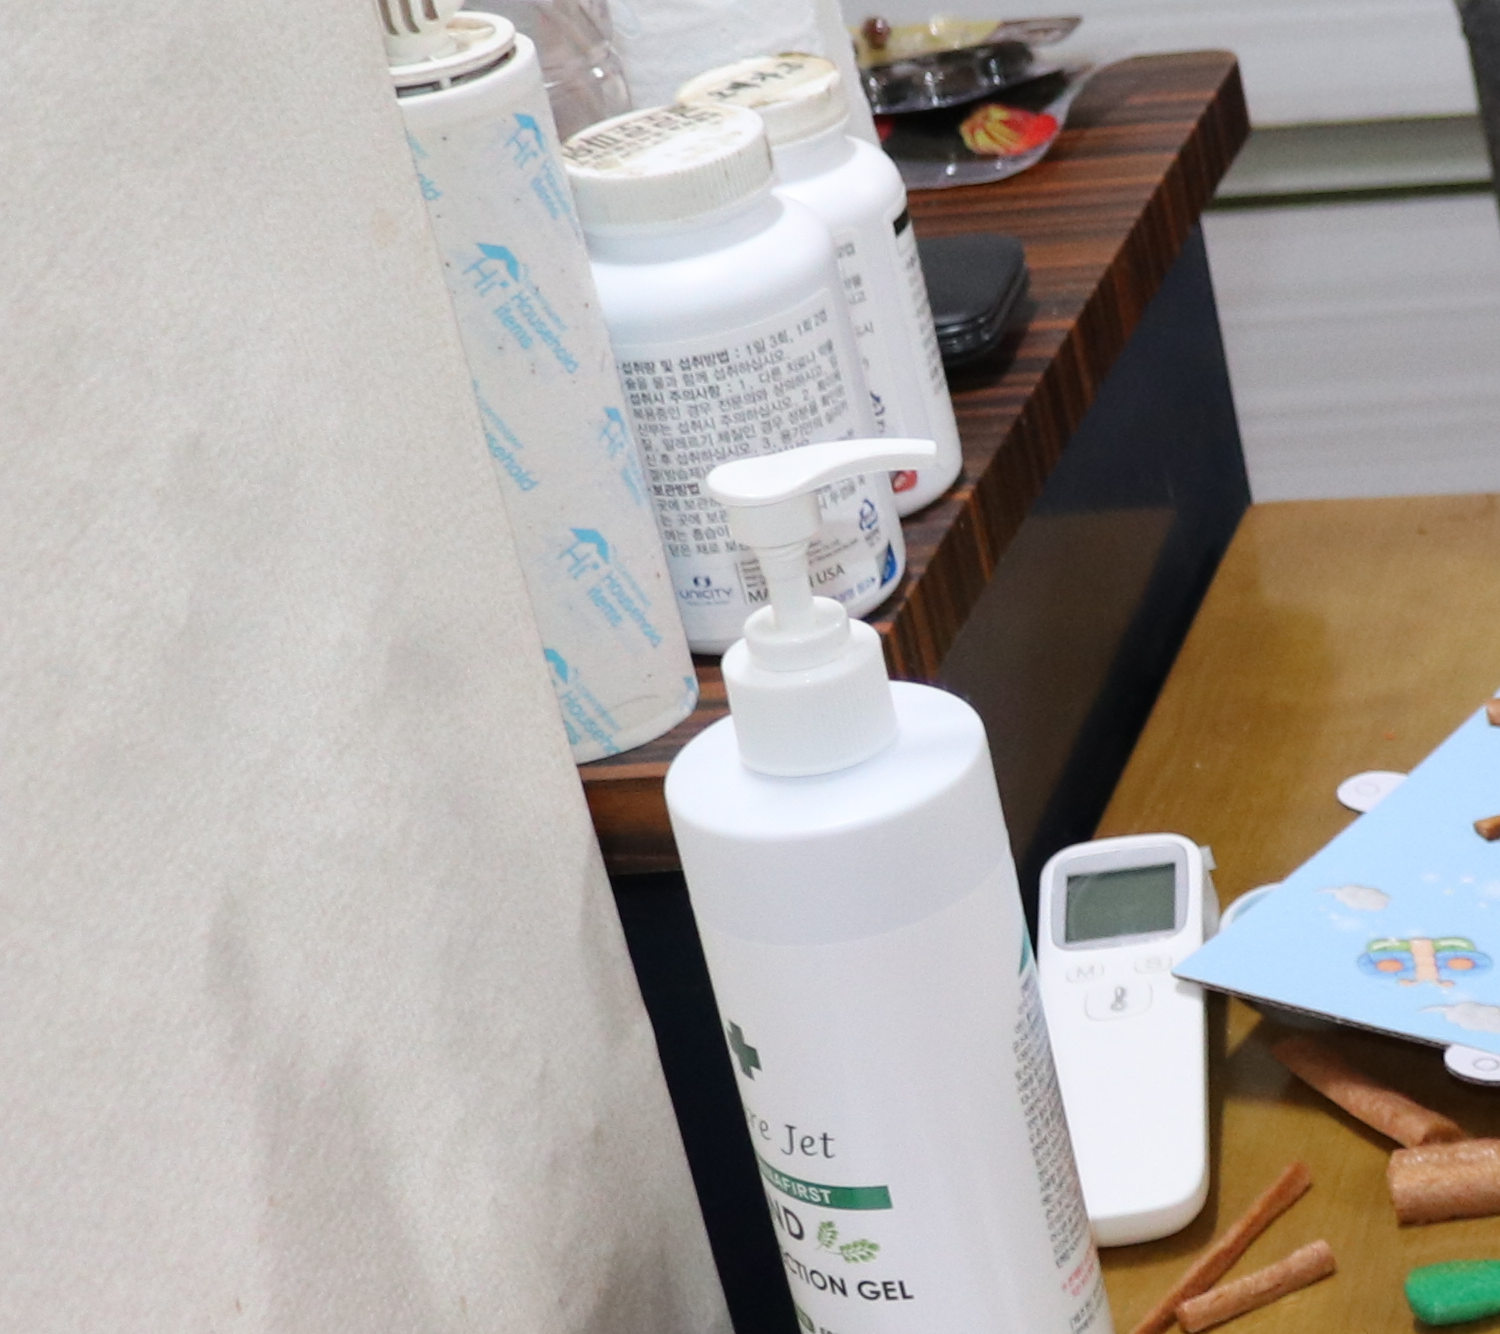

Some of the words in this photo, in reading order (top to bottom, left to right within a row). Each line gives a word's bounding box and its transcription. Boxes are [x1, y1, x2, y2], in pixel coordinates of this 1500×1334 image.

[680, 349, 730, 371] 섭취방법
[669, 385, 721, 404] 주의사항
[816, 565, 845, 585] USA
[781, 1124, 836, 1159] Jet
[769, 1198, 805, 1241] ND
[857, 1279, 914, 1301] GEL
